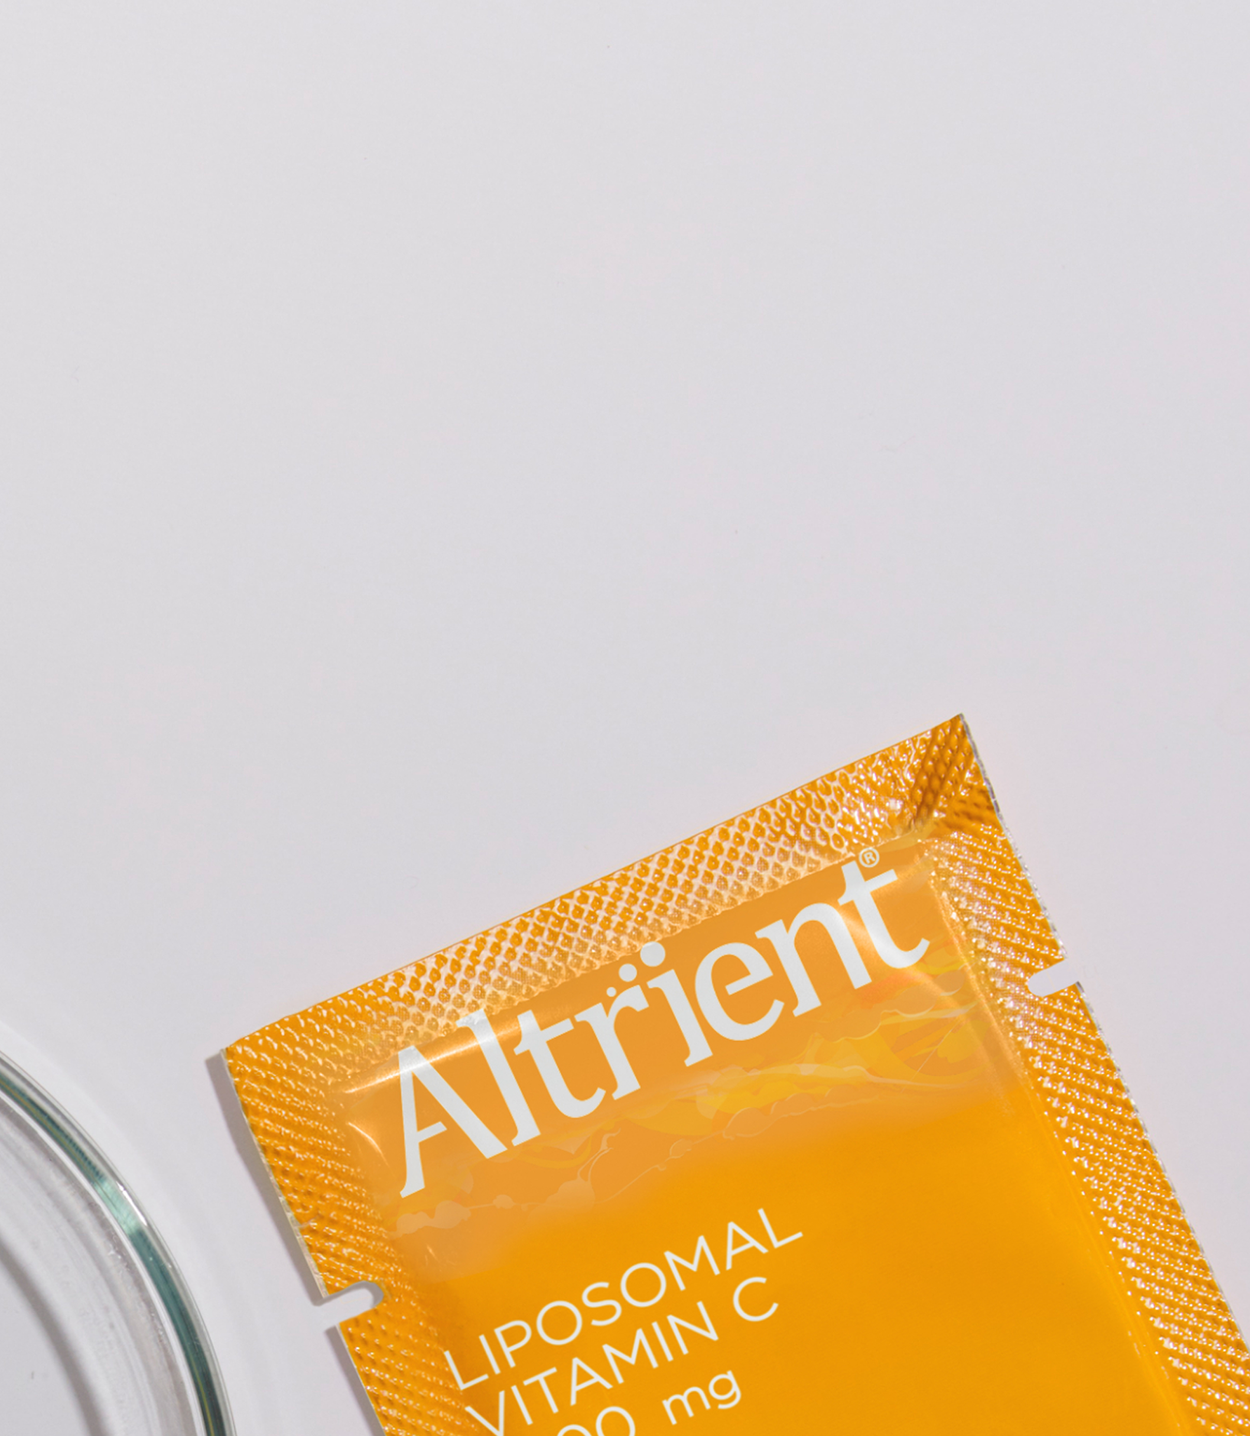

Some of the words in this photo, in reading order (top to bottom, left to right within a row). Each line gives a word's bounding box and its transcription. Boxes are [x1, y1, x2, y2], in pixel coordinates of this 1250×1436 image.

[443, 1208, 803, 1391] LIPOSOMAL
[732, 1276, 779, 1322] C
[662, 1367, 742, 1425] mg
